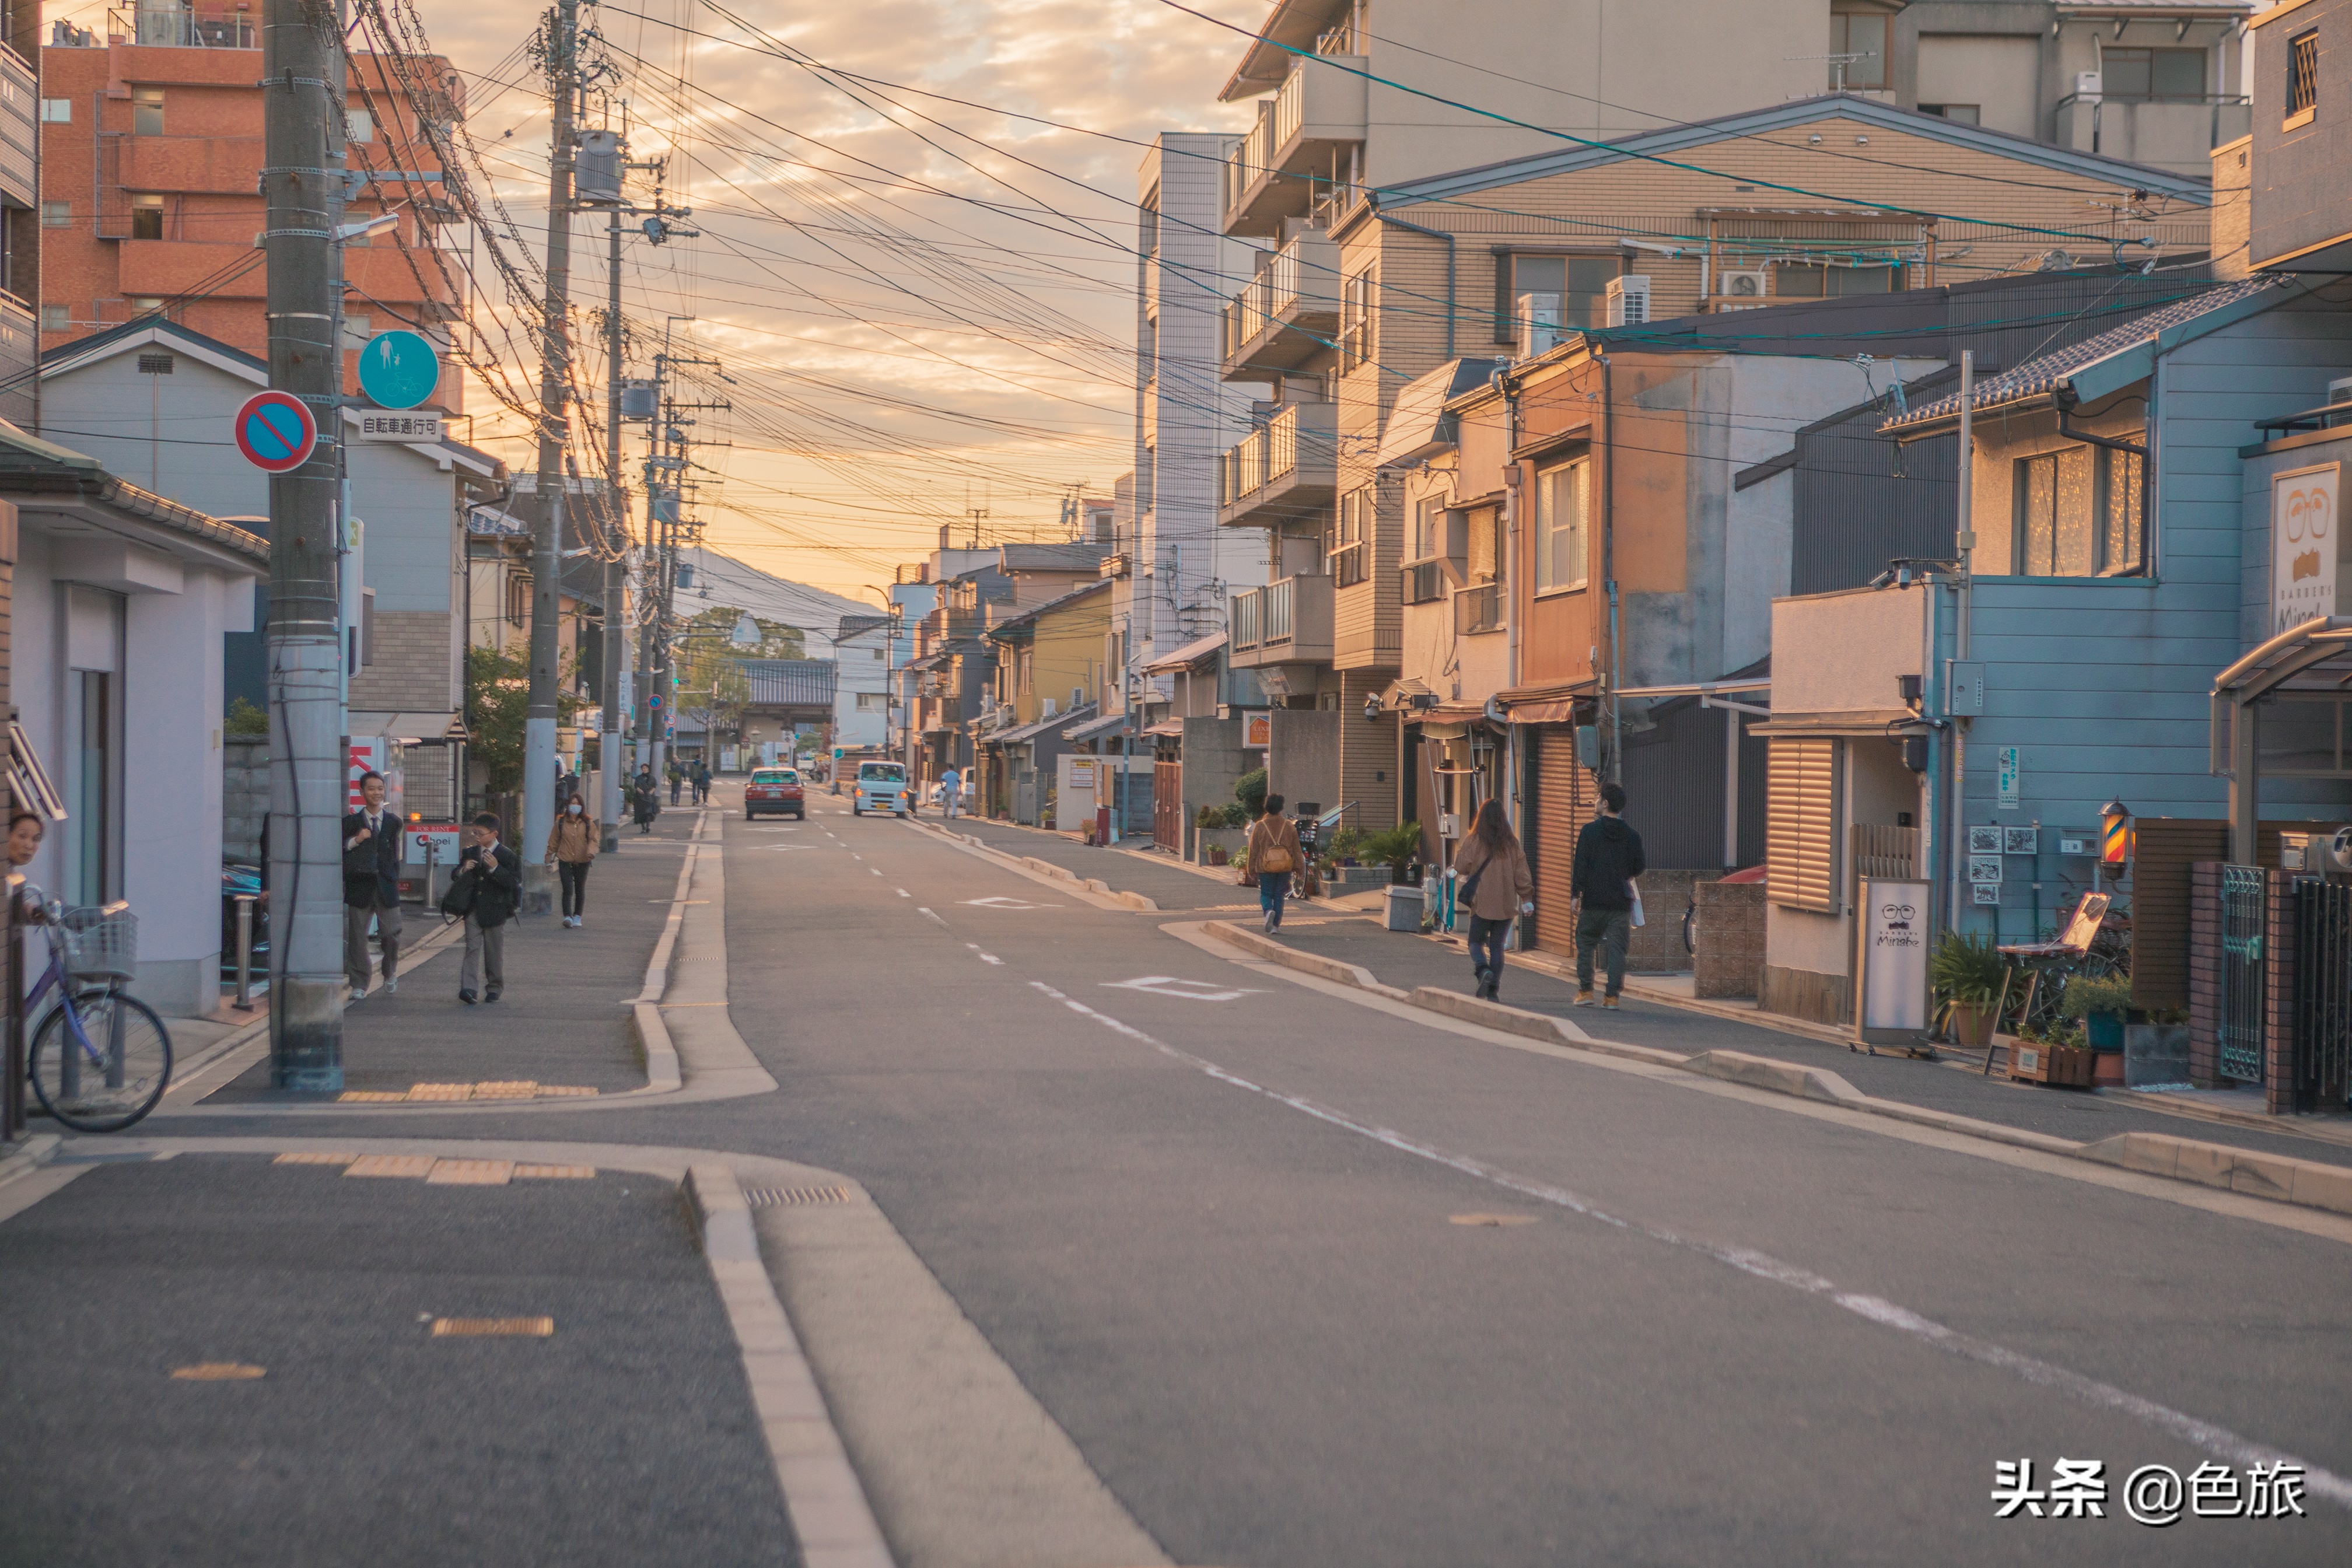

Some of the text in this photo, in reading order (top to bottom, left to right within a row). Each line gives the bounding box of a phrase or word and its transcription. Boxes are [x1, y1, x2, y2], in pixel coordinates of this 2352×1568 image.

[364, 417, 438, 435] 自転車通行可
[2281, 584, 2331, 600] BARBER'S
[1877, 936, 1919, 947] Minabe
